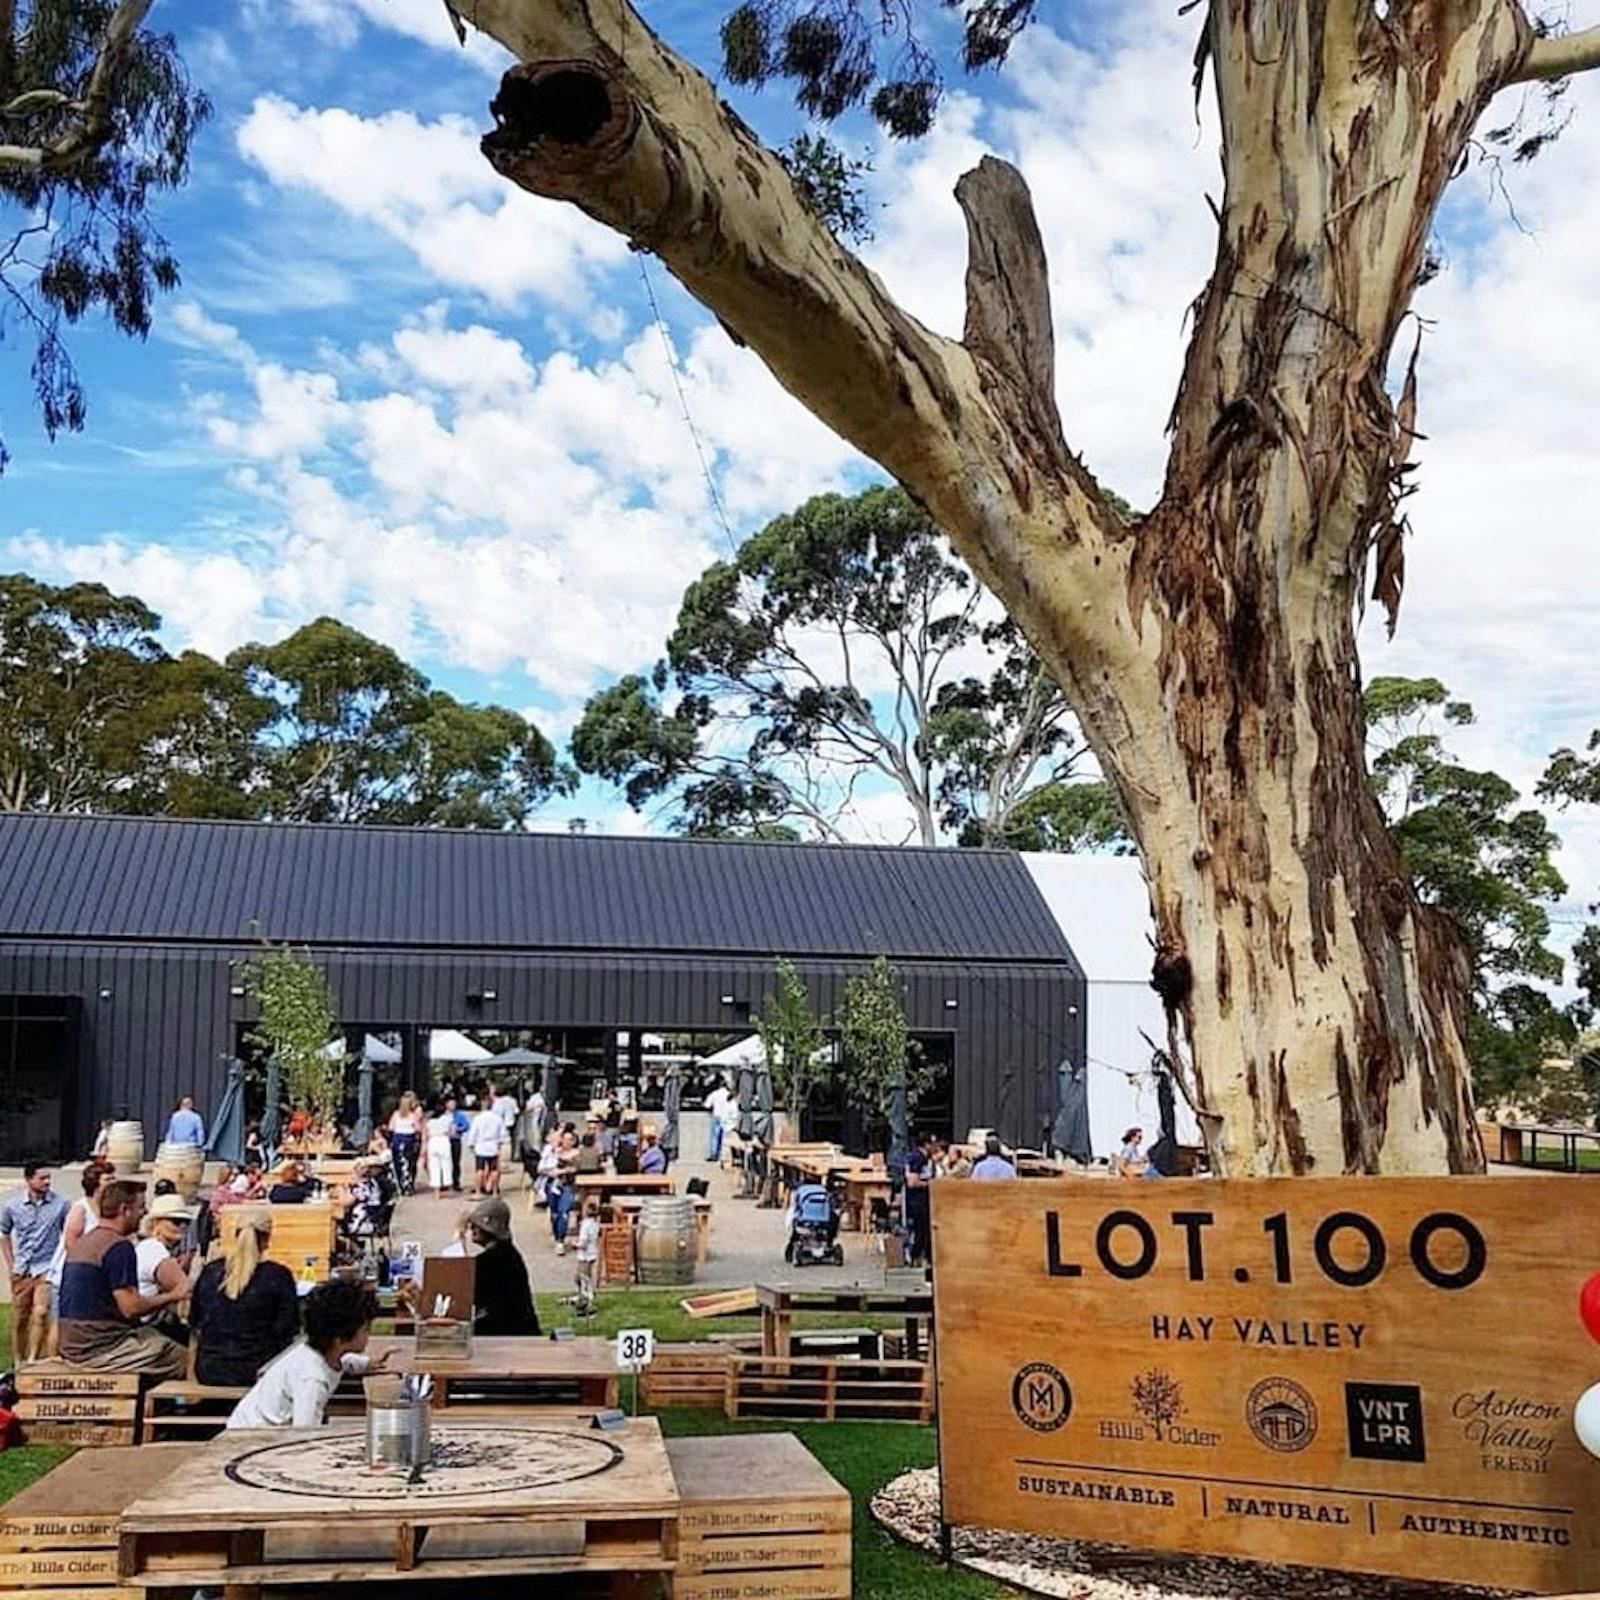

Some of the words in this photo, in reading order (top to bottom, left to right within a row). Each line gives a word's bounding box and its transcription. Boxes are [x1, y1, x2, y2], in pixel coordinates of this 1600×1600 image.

[1152, 1315, 1214, 1341] HAY
[1234, 1319, 1366, 1349] VALLEY
[622, 1335, 647, 1359] 38
[1358, 1399, 1410, 1422] VNT
[1453, 1390, 1562, 1421] Ashton
[1100, 1420, 1145, 1441] Hills
[1168, 1426, 1222, 1446] Cider
[1362, 1422, 1412, 1446] LPR
[1464, 1419, 1557, 1455] Valley
[1481, 1454, 1550, 1474] FRESH
[1018, 1476, 1175, 1507] SUSTAINABLE
[1225, 1497, 1350, 1524] NATURAL
[1400, 1514, 1571, 1546] AUTHENTIC
[33, 1522, 67, 1535] Hills
[70, 1522, 110, 1535] Cider
[31, 1561, 64, 1574] Hills
[67, 1560, 107, 1574] Cider
